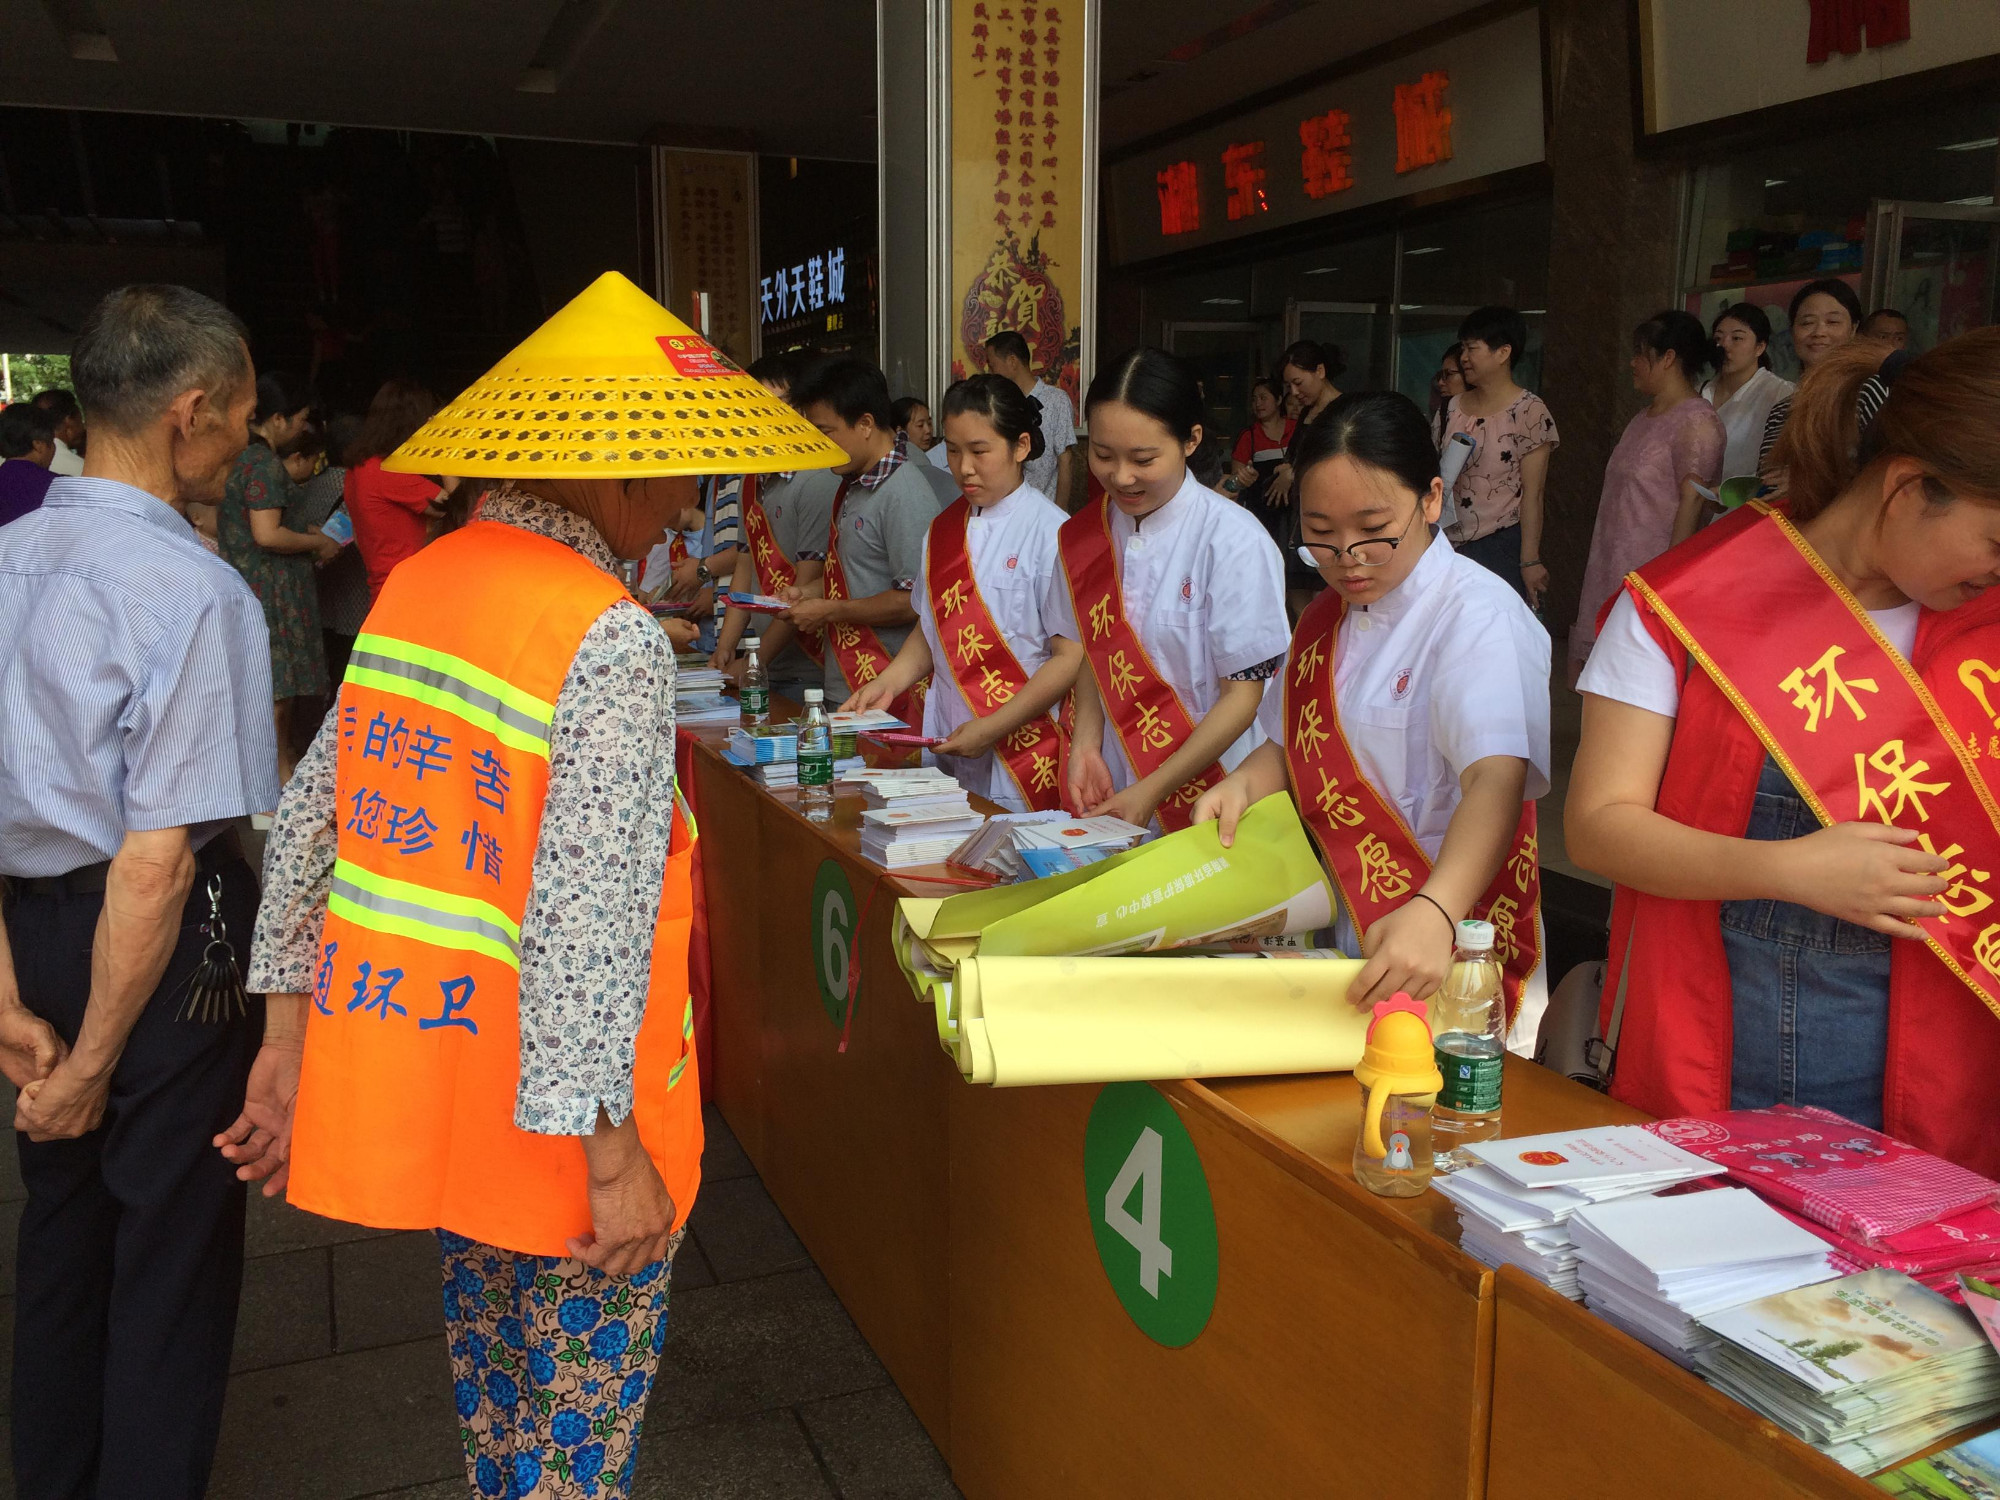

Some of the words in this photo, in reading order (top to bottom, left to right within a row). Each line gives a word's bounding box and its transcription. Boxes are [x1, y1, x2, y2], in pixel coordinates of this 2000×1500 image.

[760, 247, 846, 325] 天外天鞋城
[344, 706, 511, 815] 的辛苦
[1294, 632, 1413, 905] 环保志愿
[821, 889, 850, 1001] 6
[1105, 1125, 1172, 1301] 4
